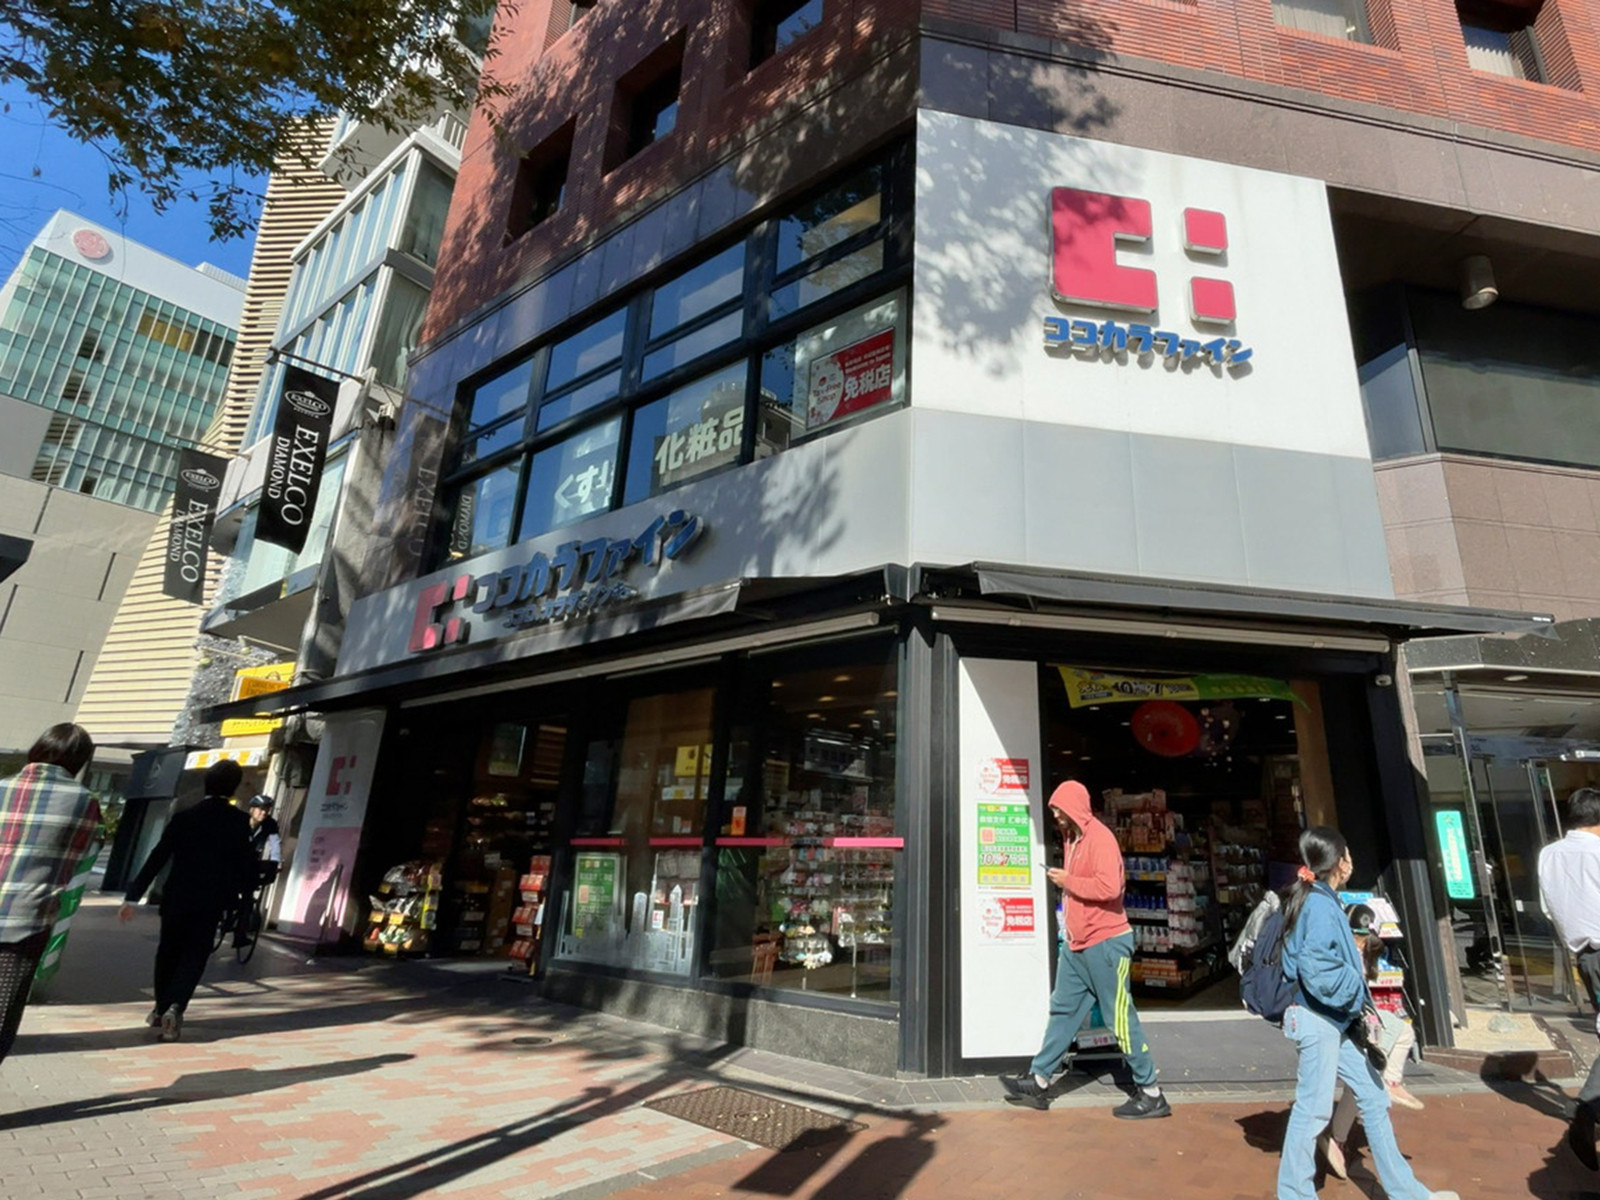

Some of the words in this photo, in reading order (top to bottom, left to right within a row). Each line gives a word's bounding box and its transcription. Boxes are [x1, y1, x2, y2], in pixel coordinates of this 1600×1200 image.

[1044, 316, 1254, 367] ココカラファイン
[844, 363, 891, 402] 免税店
[267, 435, 291, 499] DIAMOND
[655, 405, 744, 475] 化粧品
[281, 424, 320, 526] EXELCO
[169, 508, 187, 563] DIAMOND
[180, 498, 209, 584] EXELCO
[473, 508, 704, 614] ココカラファイン
